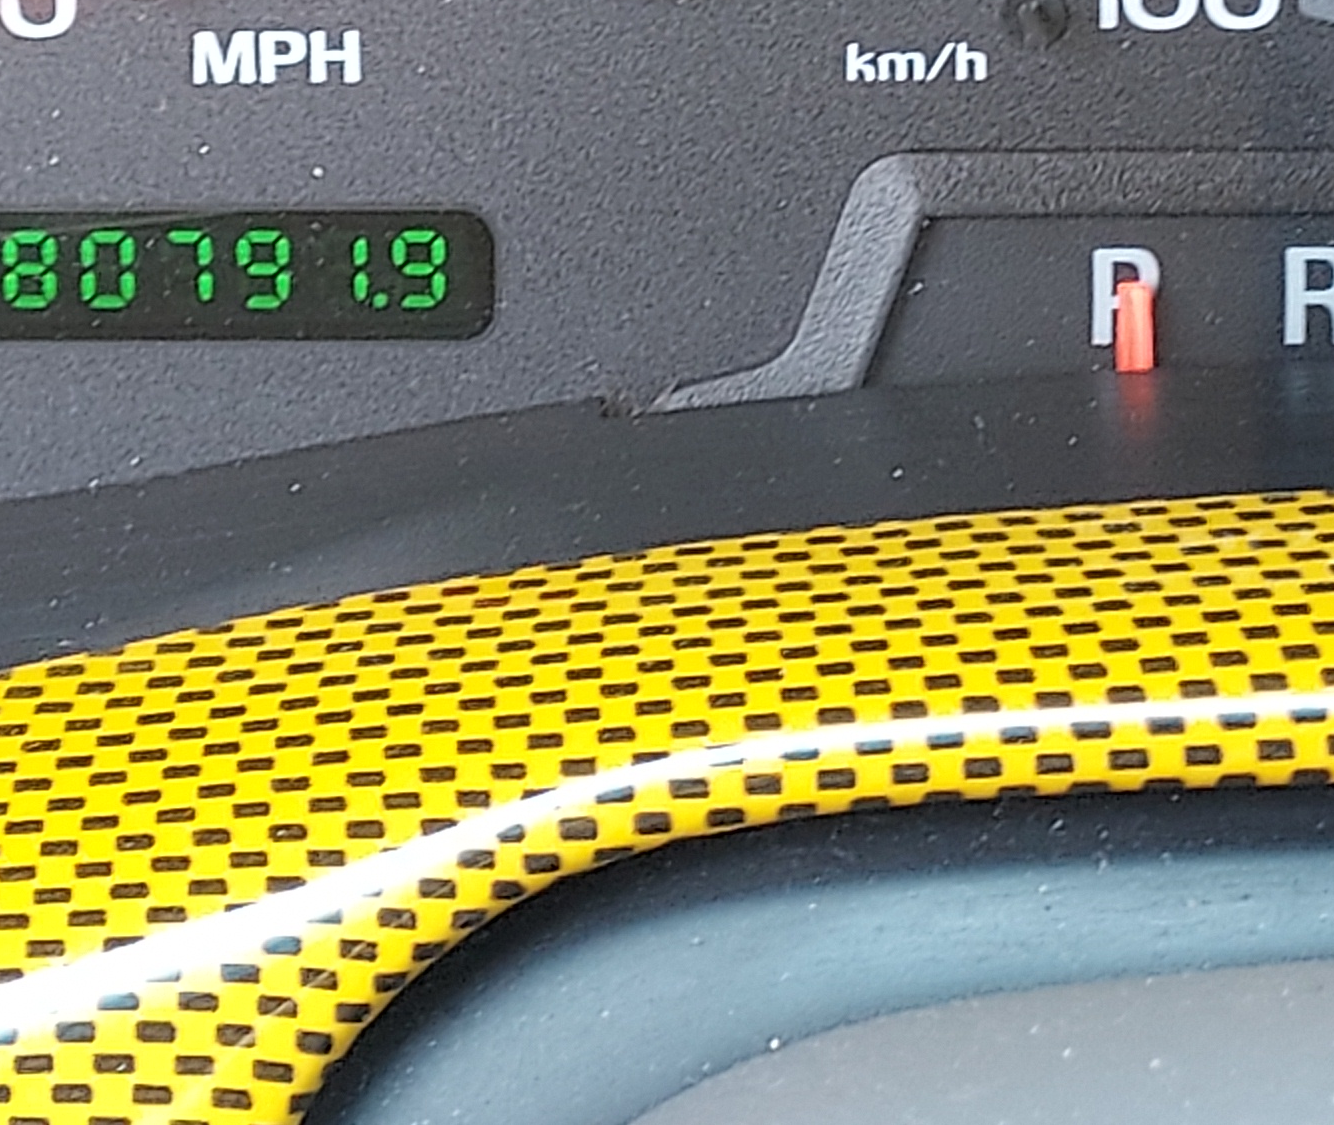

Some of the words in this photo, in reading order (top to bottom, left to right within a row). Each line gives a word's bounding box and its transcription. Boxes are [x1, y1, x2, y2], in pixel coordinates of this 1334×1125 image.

[192, 29, 362, 85] MPH
[846, 41, 988, 83] km/h
[1091, 246, 1161, 346] P
